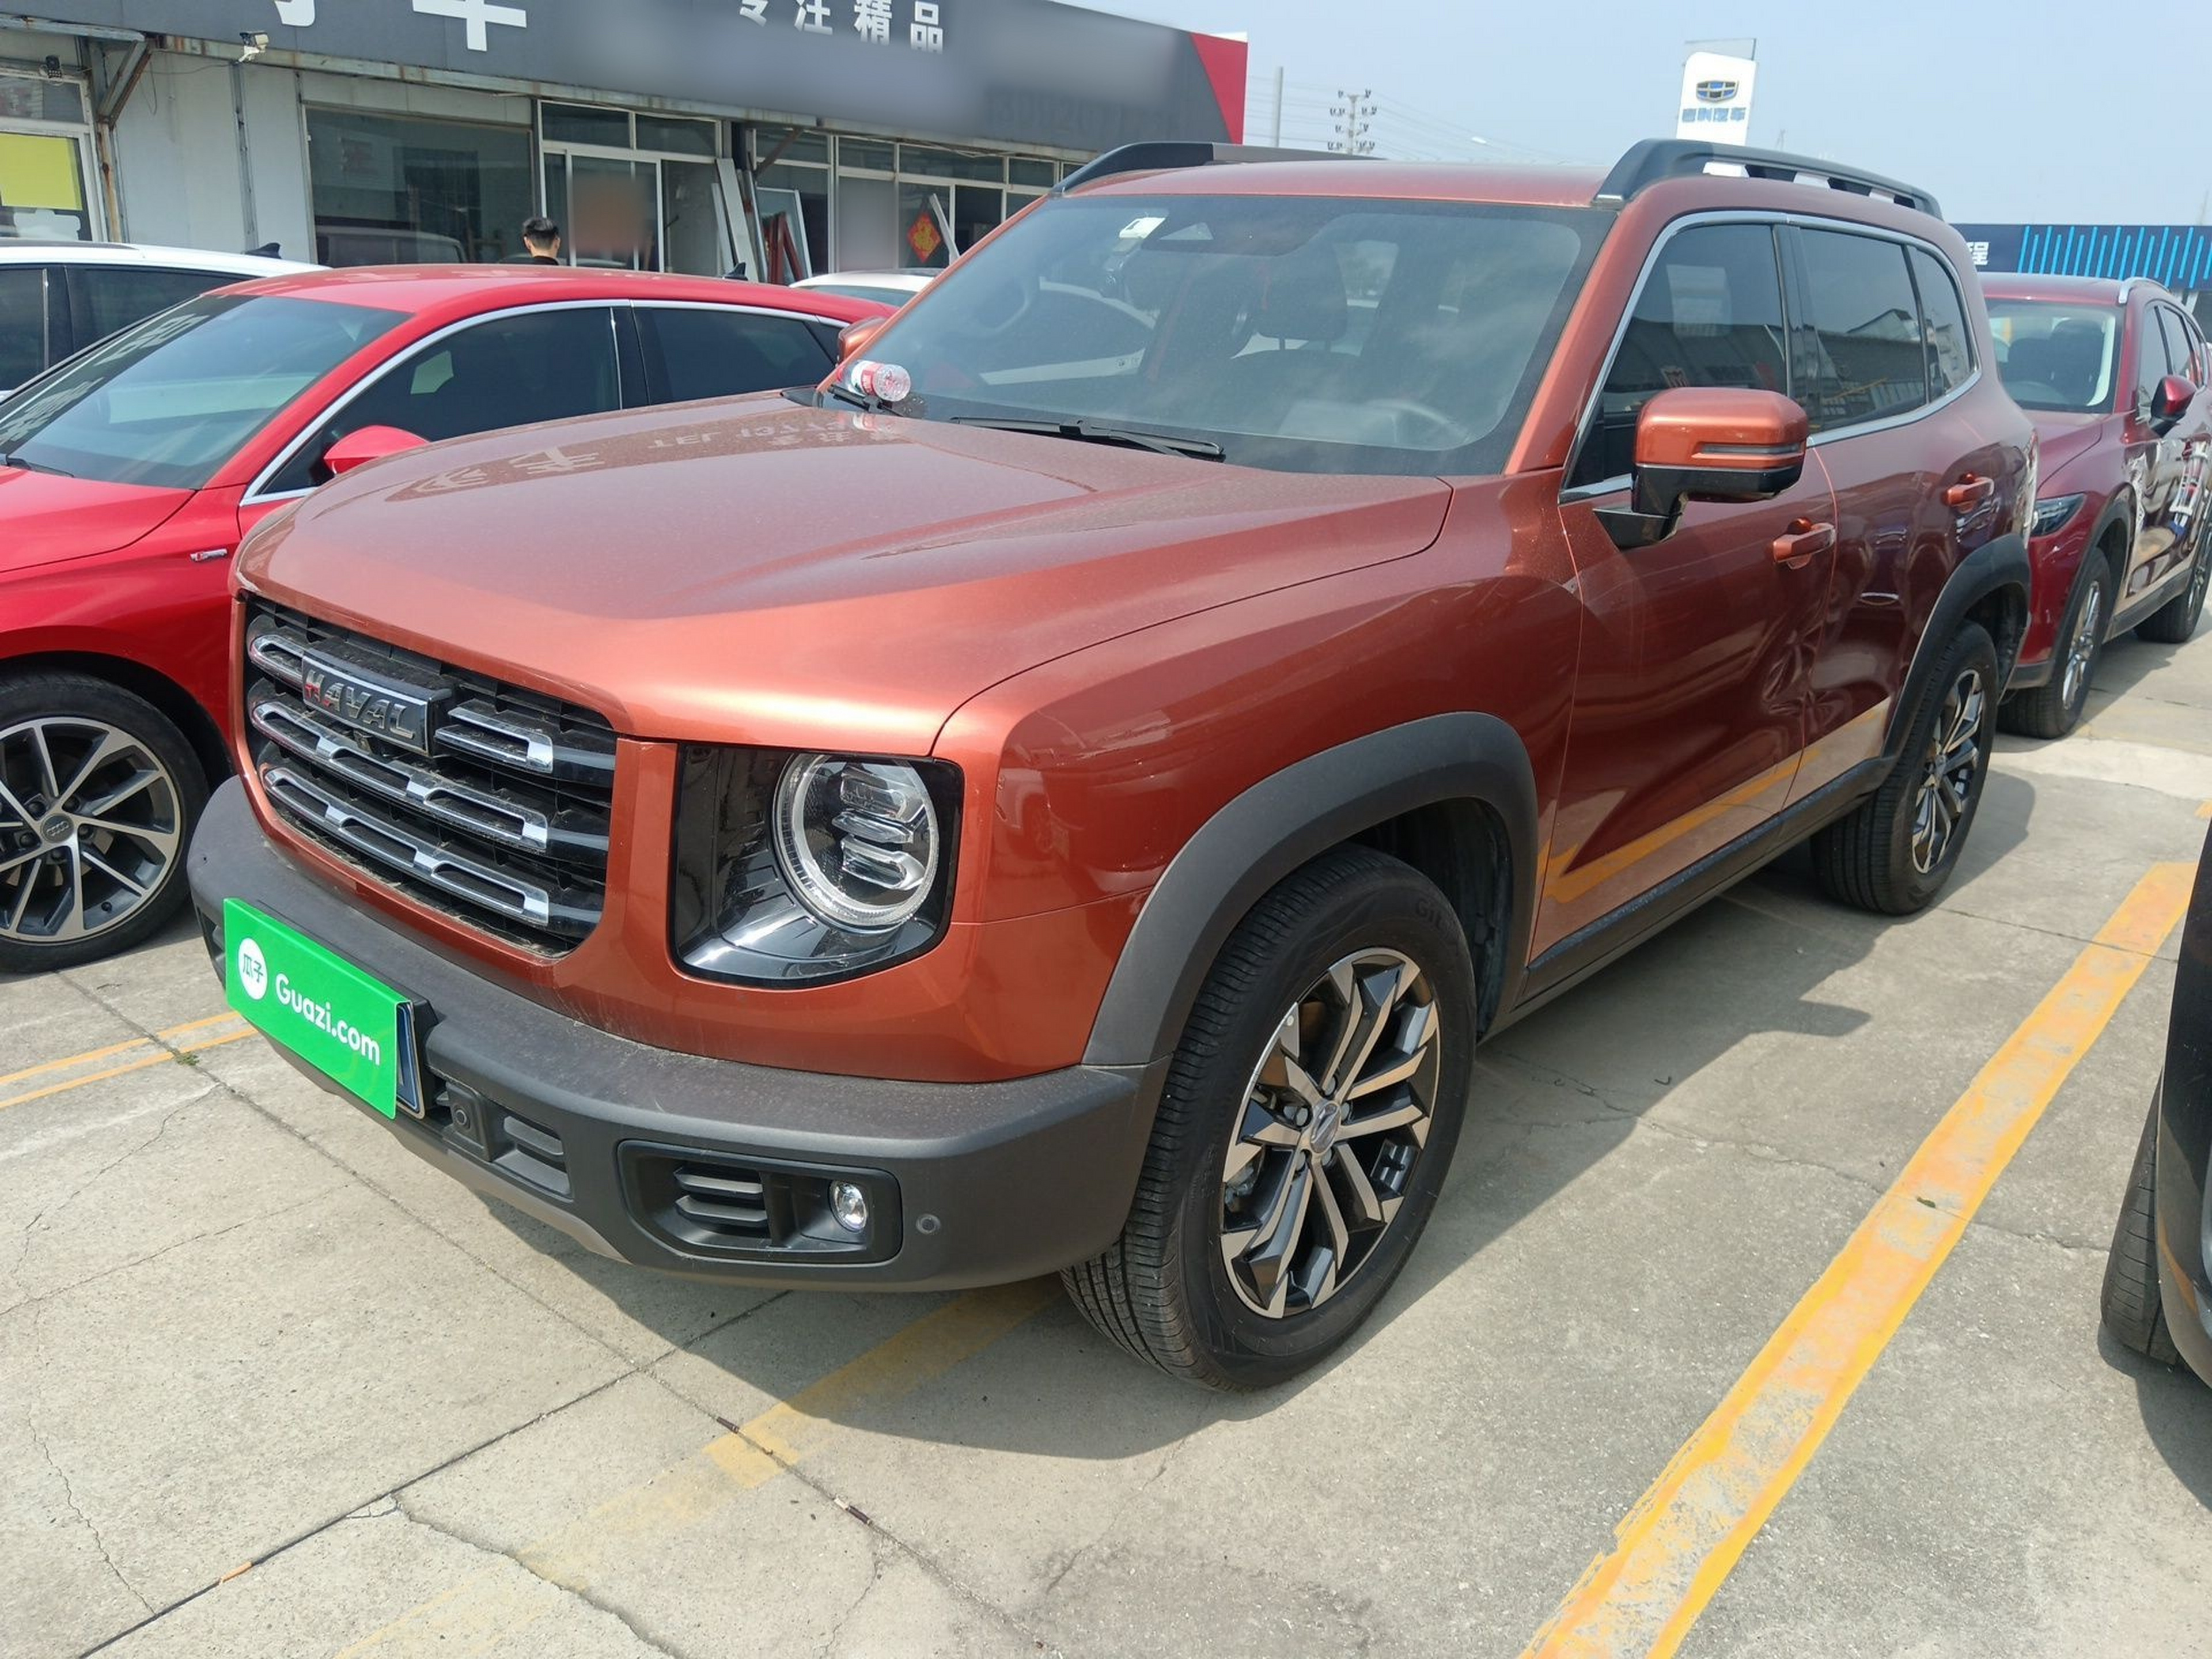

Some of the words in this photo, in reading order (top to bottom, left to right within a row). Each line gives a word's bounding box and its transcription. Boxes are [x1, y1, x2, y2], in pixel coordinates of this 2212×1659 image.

[305, 669, 414, 739] HAVAL
[242, 953, 264, 983] 瓜子
[275, 972, 380, 1065] Guazi.com
